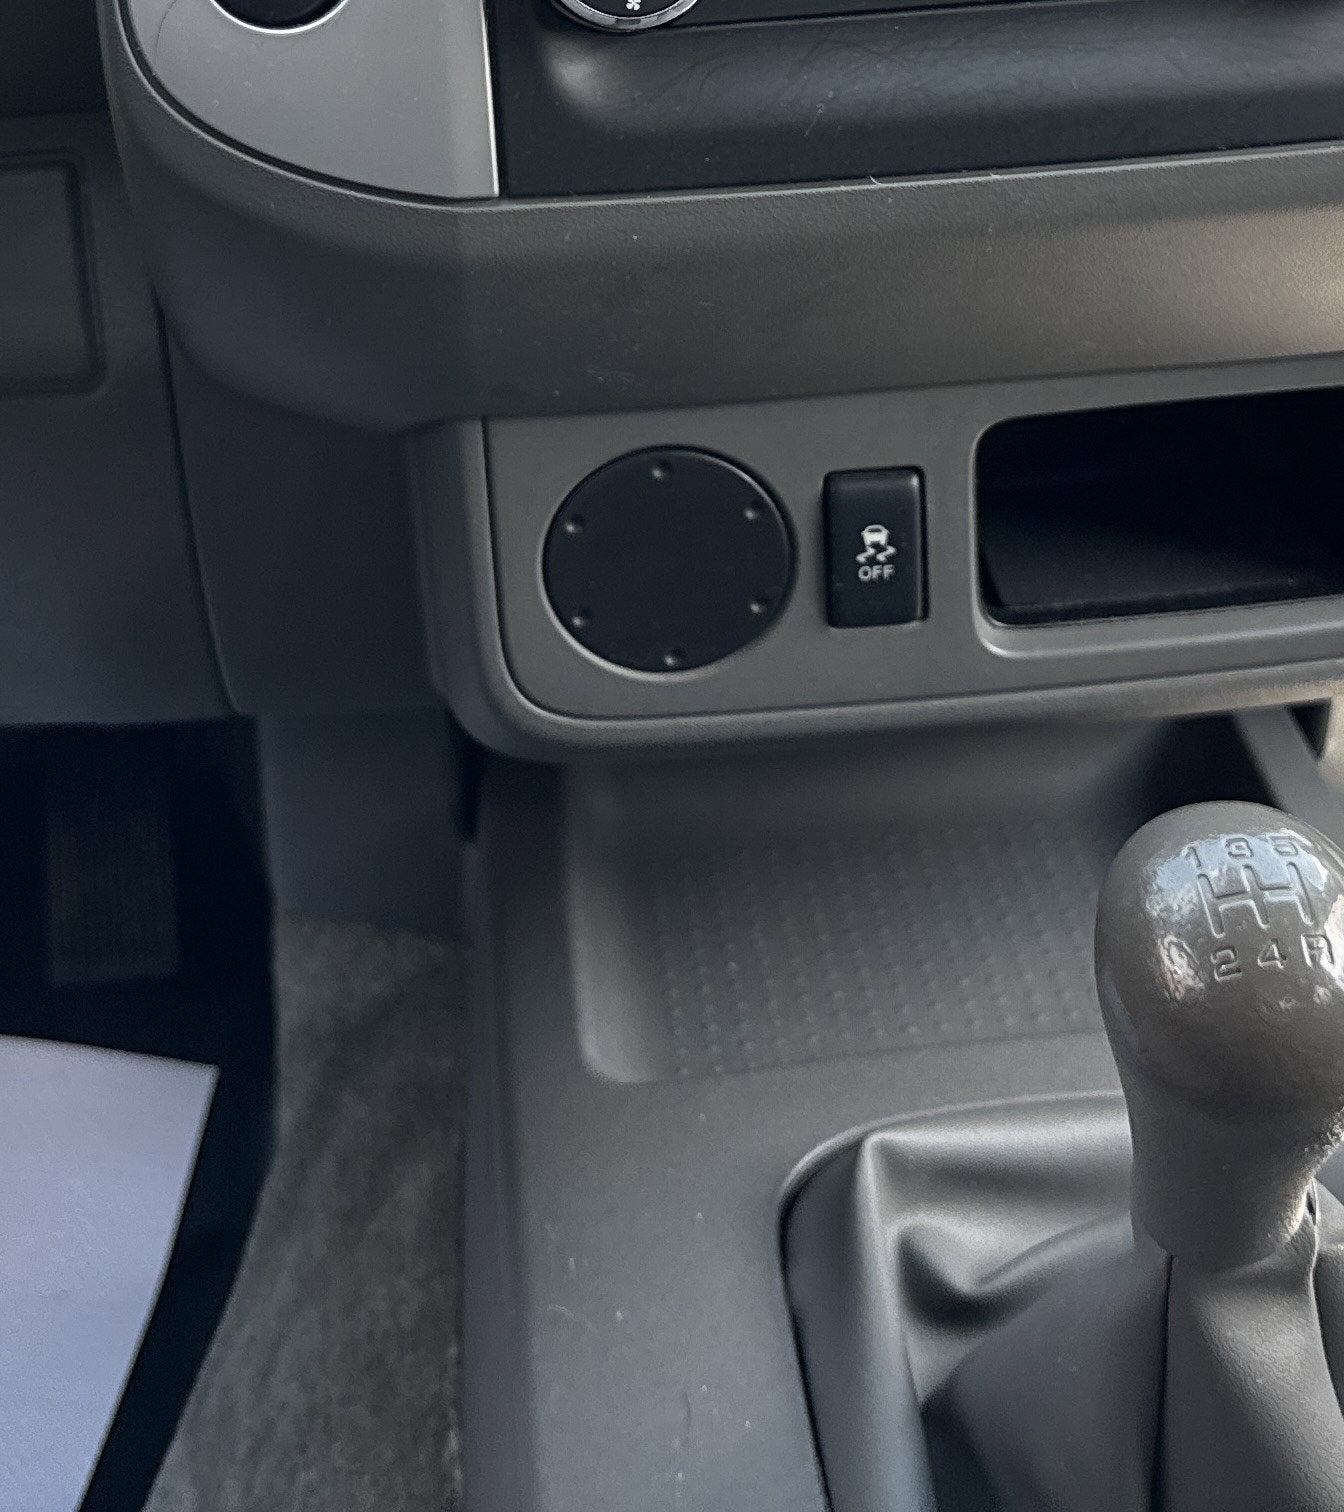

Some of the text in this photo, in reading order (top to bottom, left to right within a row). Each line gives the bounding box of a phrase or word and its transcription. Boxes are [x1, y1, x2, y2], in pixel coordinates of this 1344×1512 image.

[858, 564, 895, 582] OFF
[1209, 944, 1243, 984] 2
[1256, 937, 1287, 970] 4
